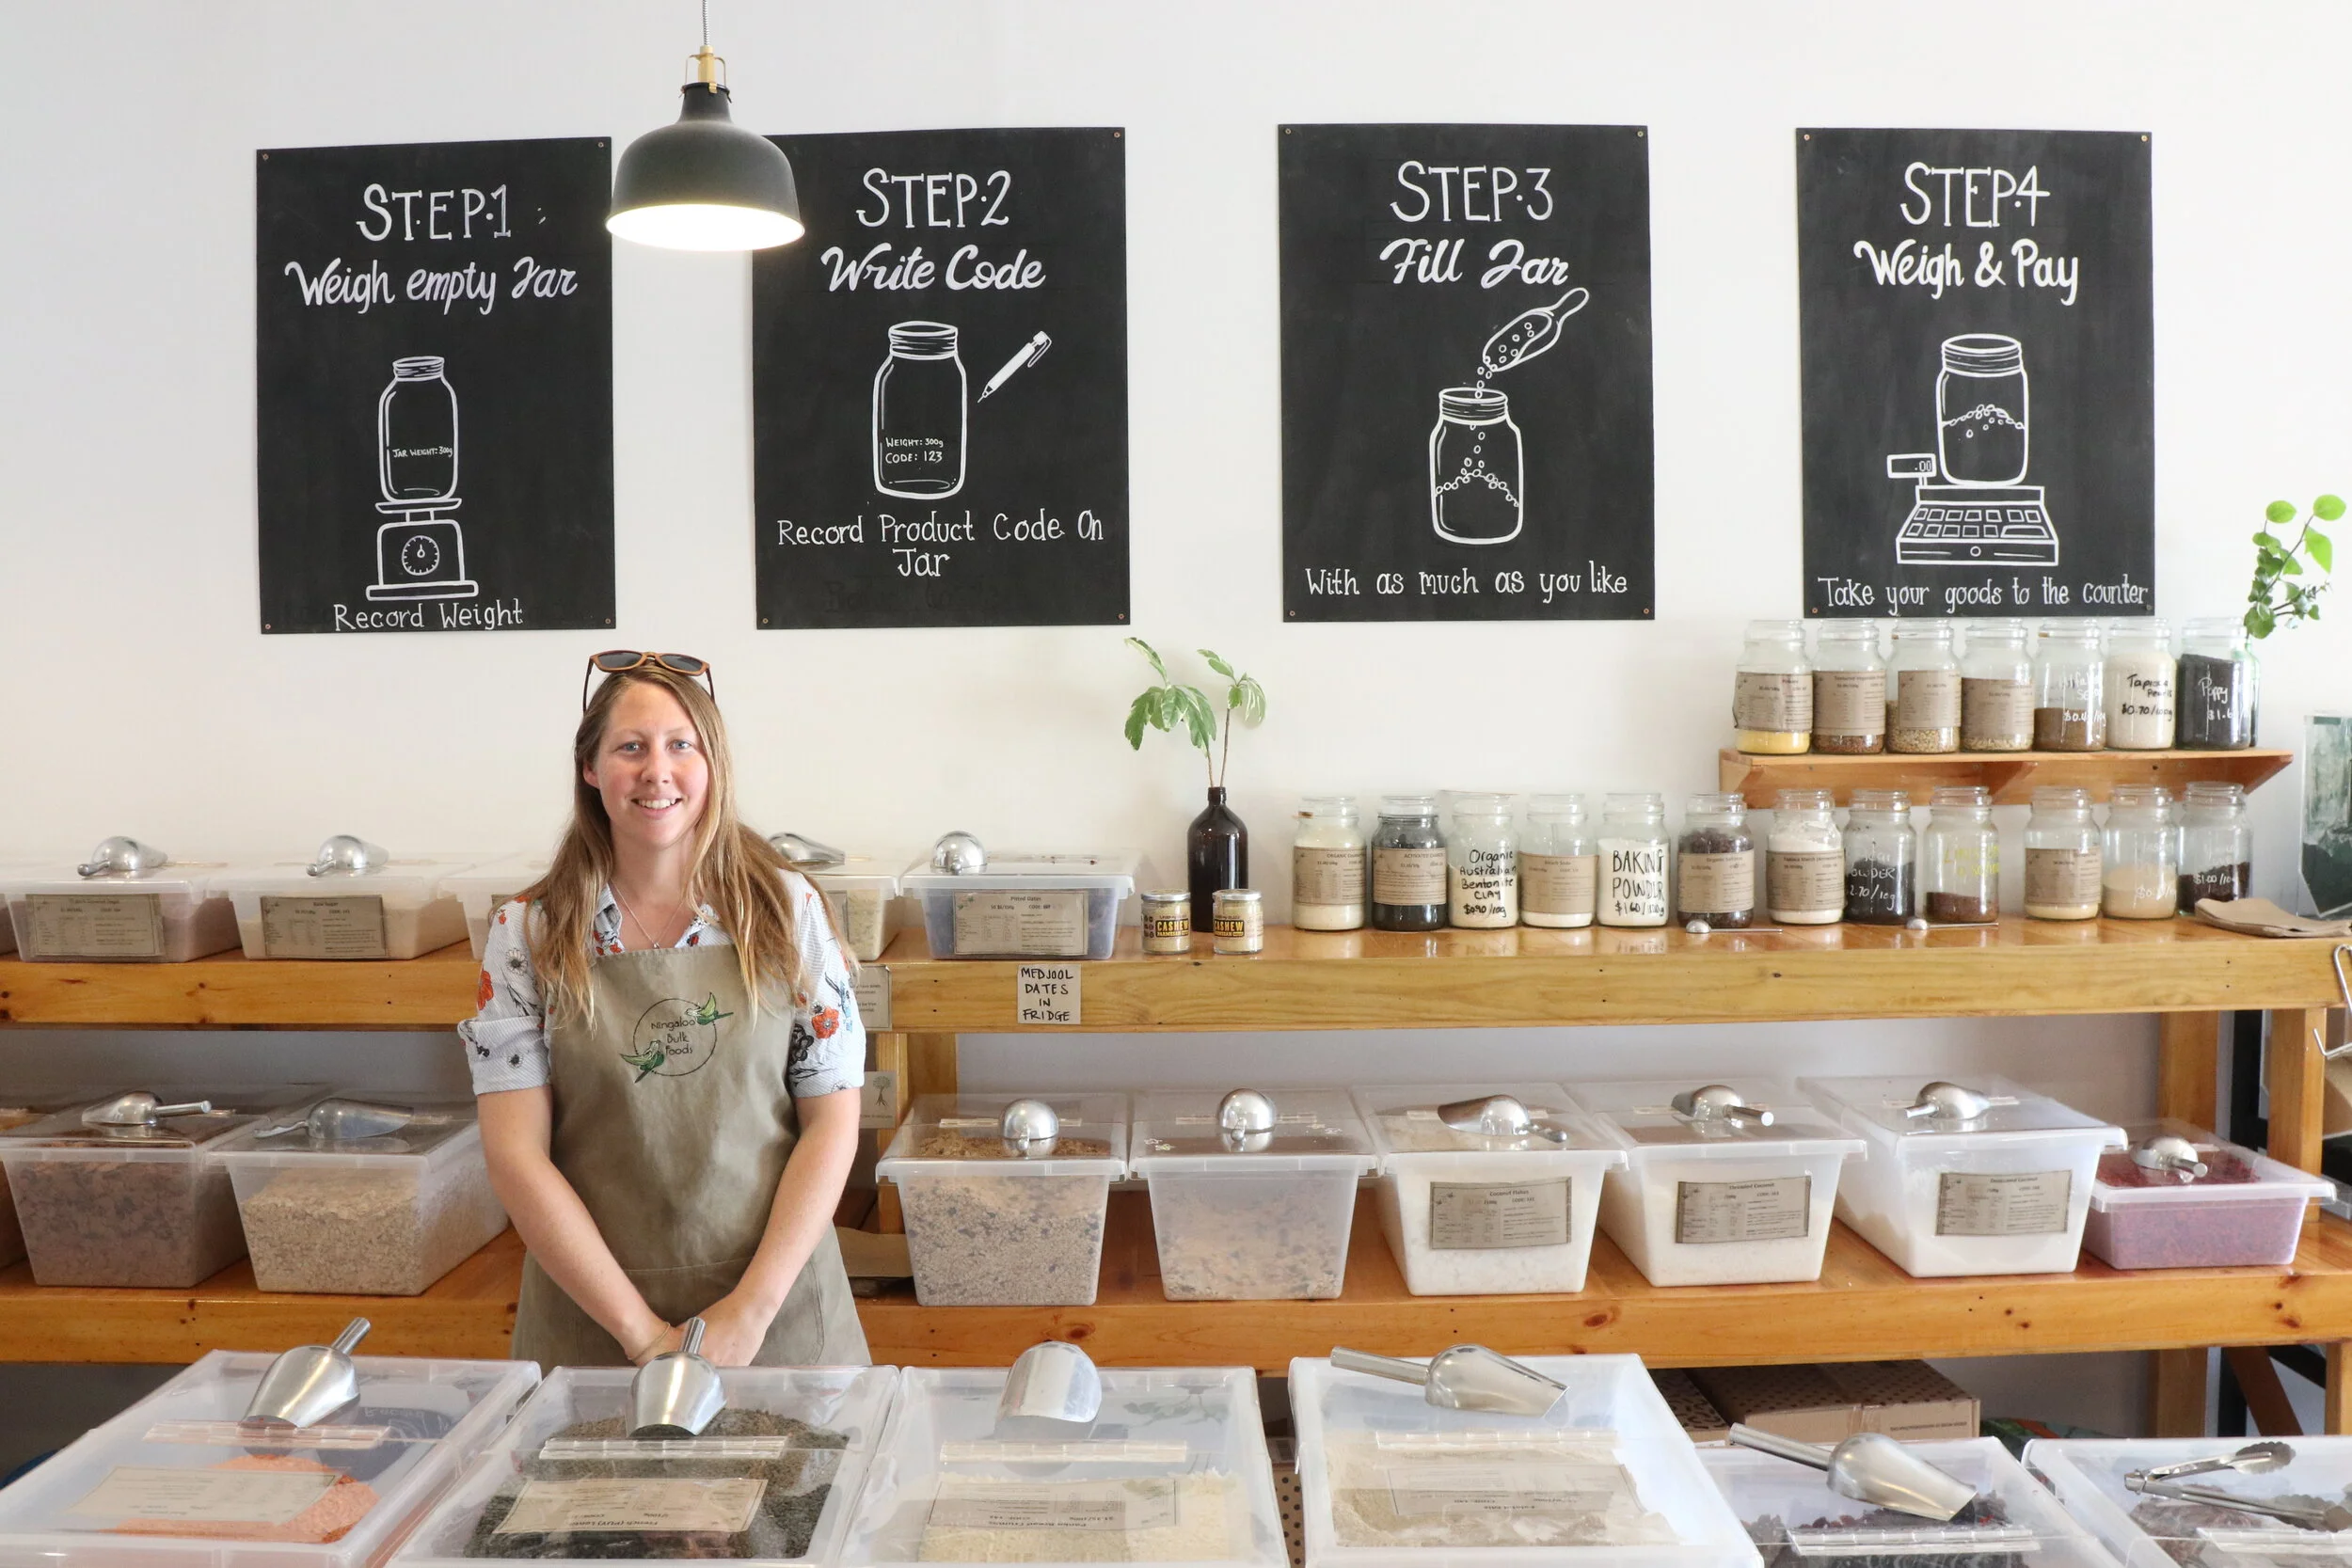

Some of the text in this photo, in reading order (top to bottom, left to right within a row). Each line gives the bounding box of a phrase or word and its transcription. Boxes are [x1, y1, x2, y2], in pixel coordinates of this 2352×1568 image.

[820, 242, 1046, 293] Write Code
[1379, 237, 1569, 289] Fill Jar
[1852, 237, 2079, 307] Weigh & Pay
[284, 256, 579, 316] Weigh empty Jar
[885, 436, 945, 449] WEIGHT: 300g
[391, 448, 408, 458] JAR
[885, 450, 943, 465] CODE: 123
[776, 507, 1104, 546] Record Product Code On
[892, 547, 950, 578] Jar
[1304, 560, 1629, 604] With as much as you like
[1817, 573, 2149, 617] Take your goods to the counter
[333, 597, 524, 631] Record Weight
[1470, 849, 1514, 868] Organic
[1460, 864, 1517, 876] Australian
[1461, 878, 1514, 890] Bentonite
[1474, 890, 1502, 900] CLAY
[1157, 920, 1189, 932] CASHEW
[1021, 967, 1074, 980] MEDJOOL
[1025, 983, 1069, 995] DATES
[1039, 997, 1051, 1006] IN
[1023, 1008, 1071, 1022] FRIDGE
[650, 1016, 696, 1031] Ningaloo
[666, 1031, 691, 1044] Bulk
[664, 1045, 693, 1055] Foods
